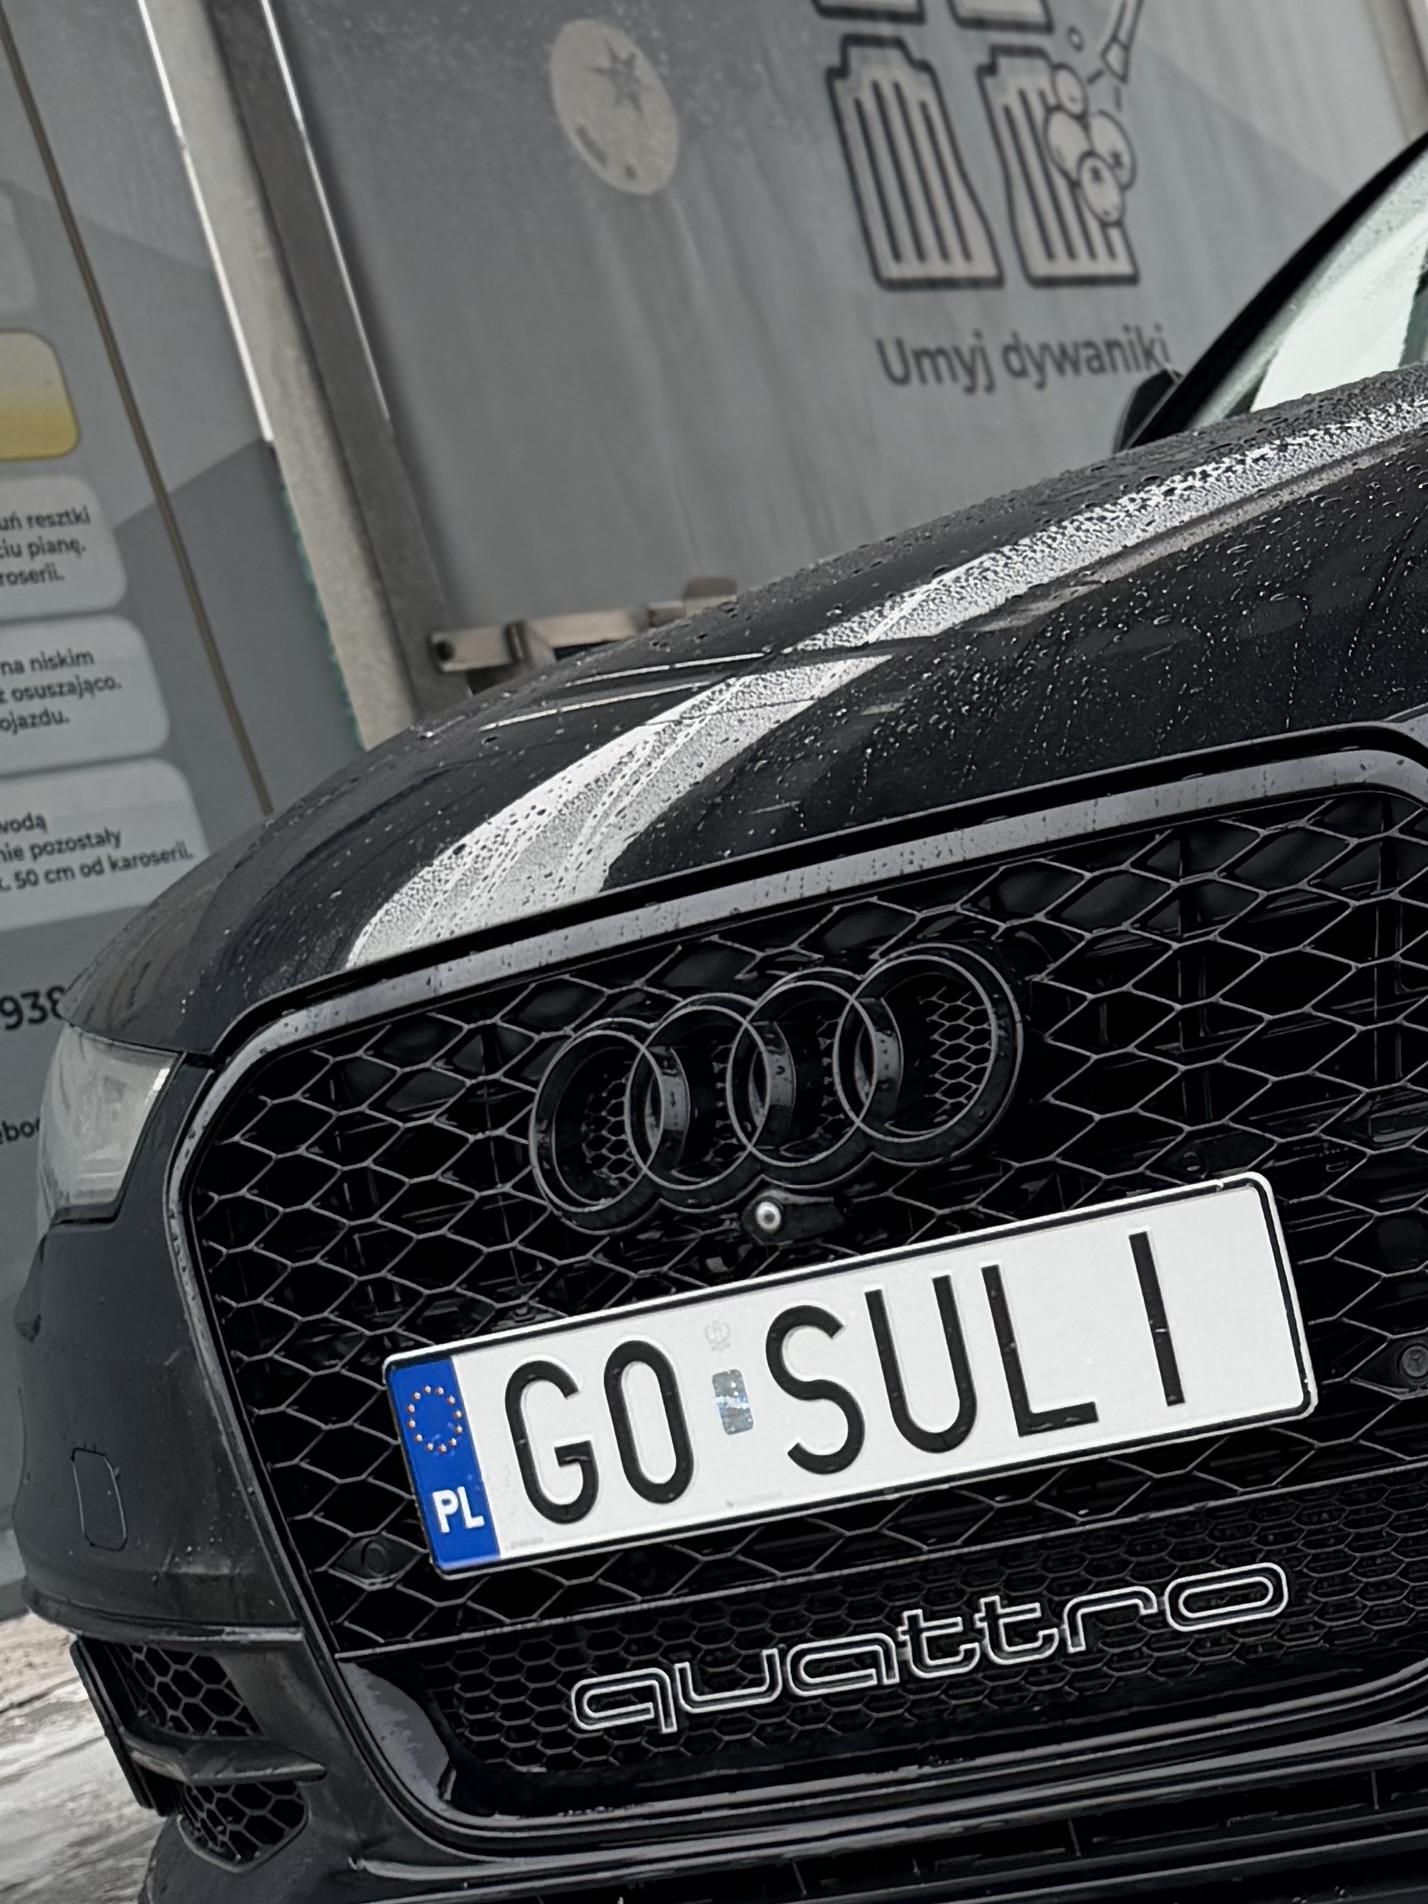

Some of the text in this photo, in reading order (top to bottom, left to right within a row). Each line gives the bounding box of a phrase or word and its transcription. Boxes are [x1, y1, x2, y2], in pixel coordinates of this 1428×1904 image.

[876, 323, 1172, 395] Umyj dywaniki
[27, 504, 91, 529] resztki
[27, 535, 87, 562] pianę.
[29, 648, 95, 673] niskim
[11, 675, 122, 702] osuszająco.
[31, 827, 122, 863] pozostały
[15, 868, 39, 891] 50
[44, 867, 76, 885] cm
[79, 856, 105, 879] od
[107, 840, 195, 874] karoserii.
[432, 1485, 486, 1534] PL
[571, 1561, 1289, 1735] quattro
